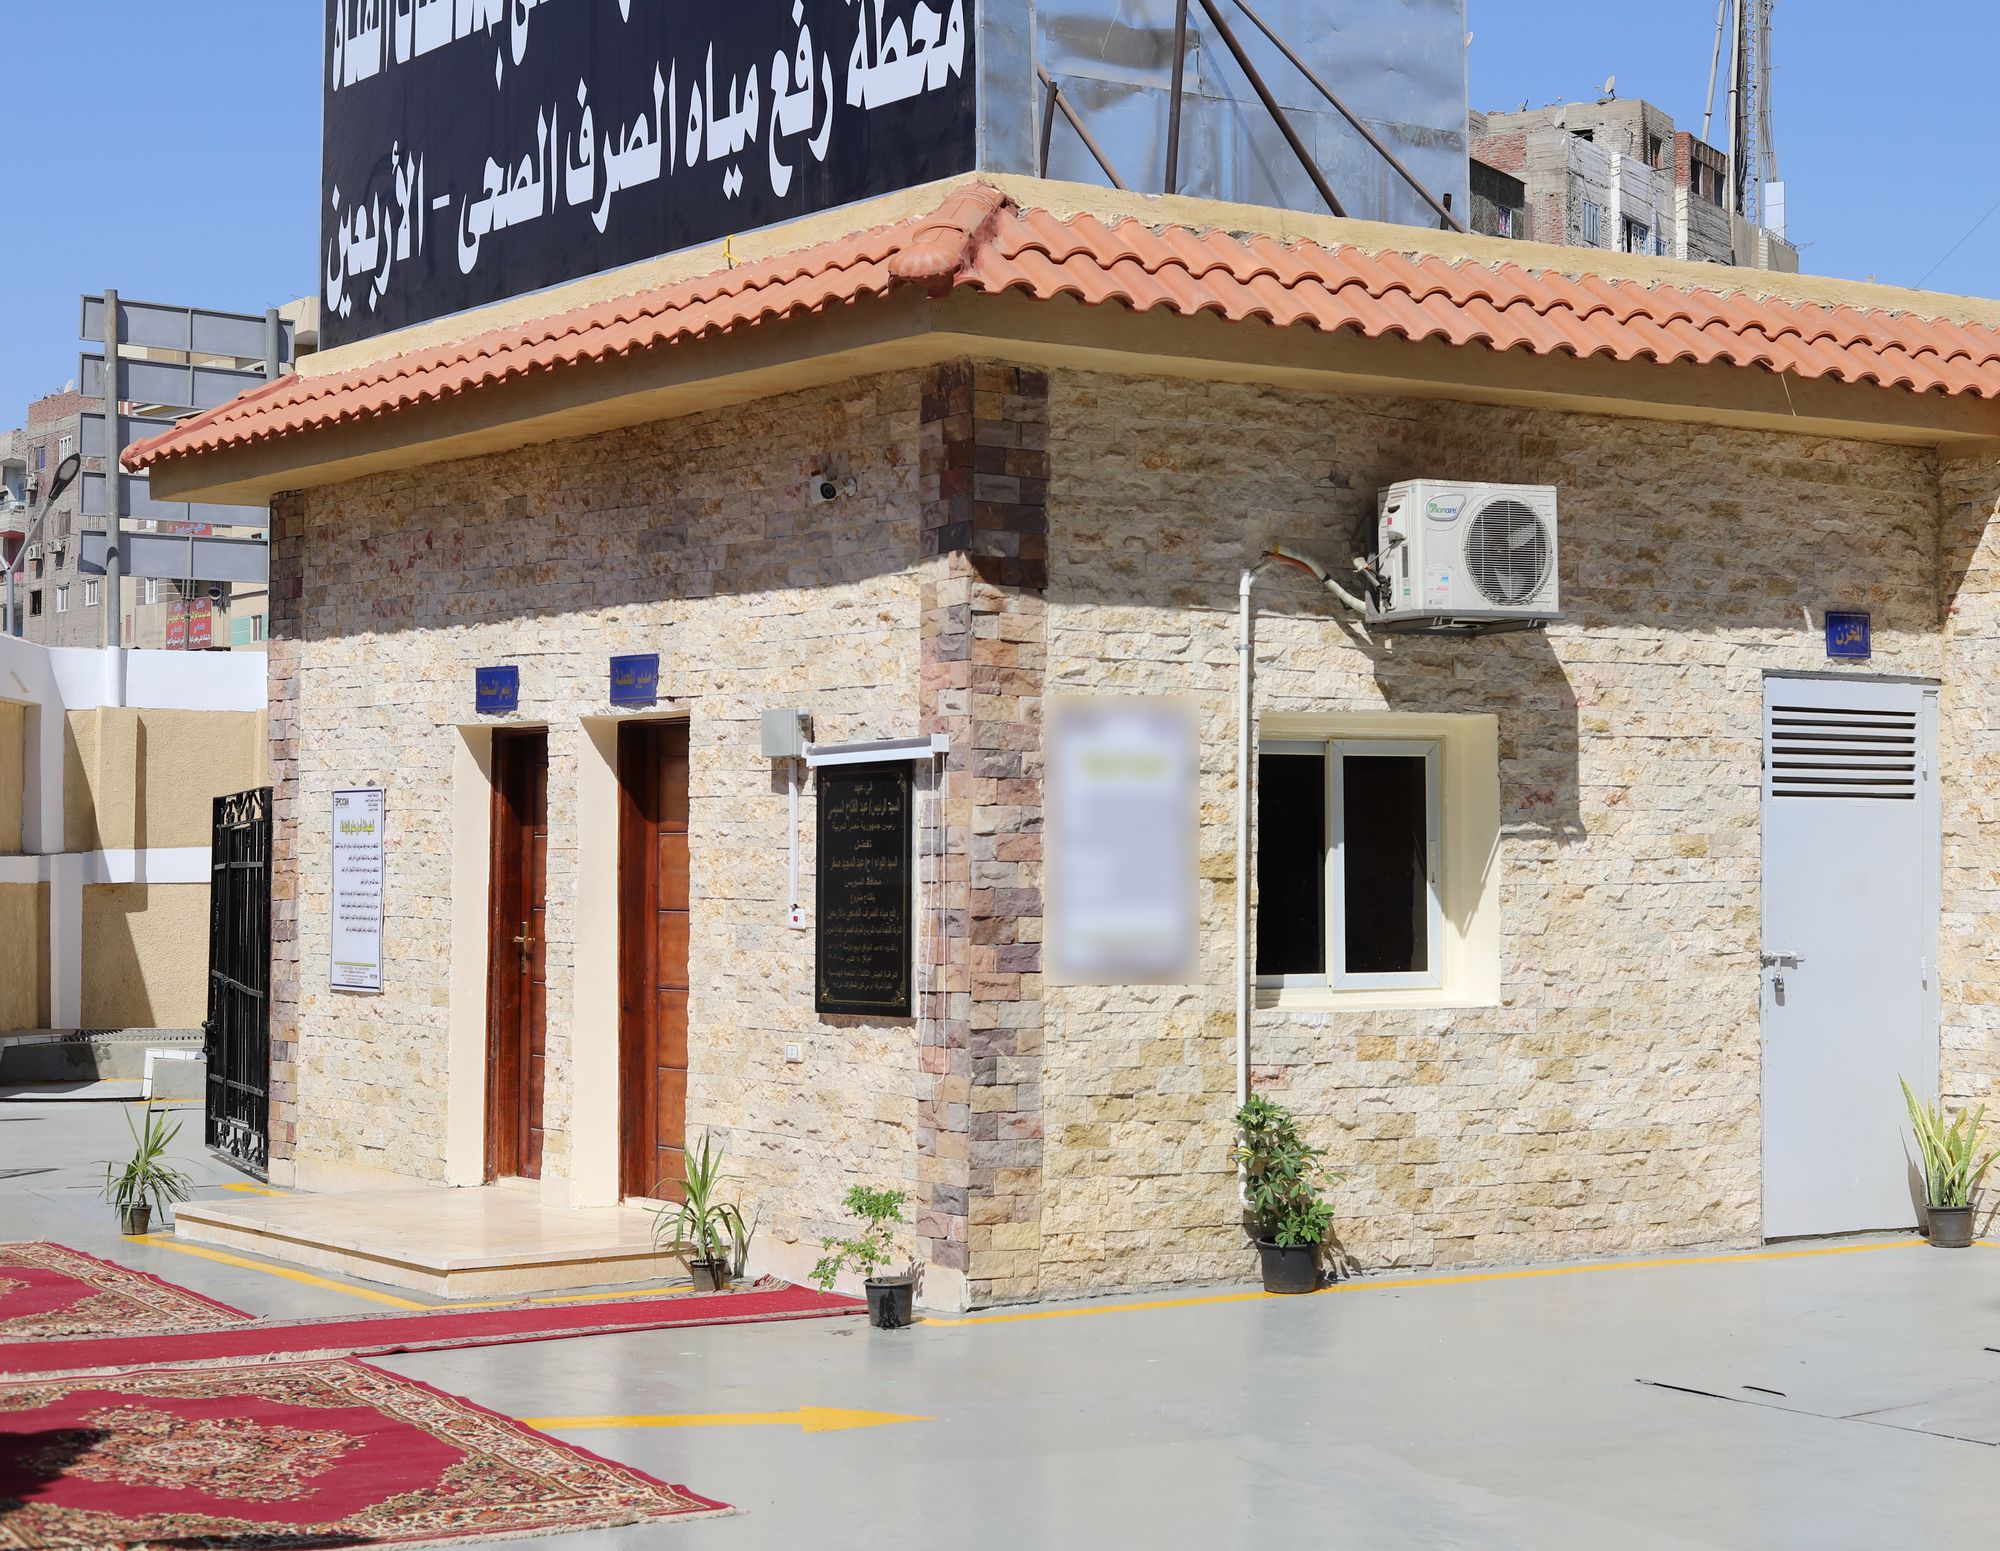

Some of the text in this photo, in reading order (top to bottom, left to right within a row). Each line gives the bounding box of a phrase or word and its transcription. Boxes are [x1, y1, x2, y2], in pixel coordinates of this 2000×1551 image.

[685, 42, 760, 200] مياه
[768, 0, 834, 198] رفع
[844, 0, 965, 111] محطة
[565, 58, 676, 234] الصرف
[326, 141, 424, 320] الأربعين
[854, 839, 872, 850] تفضل
